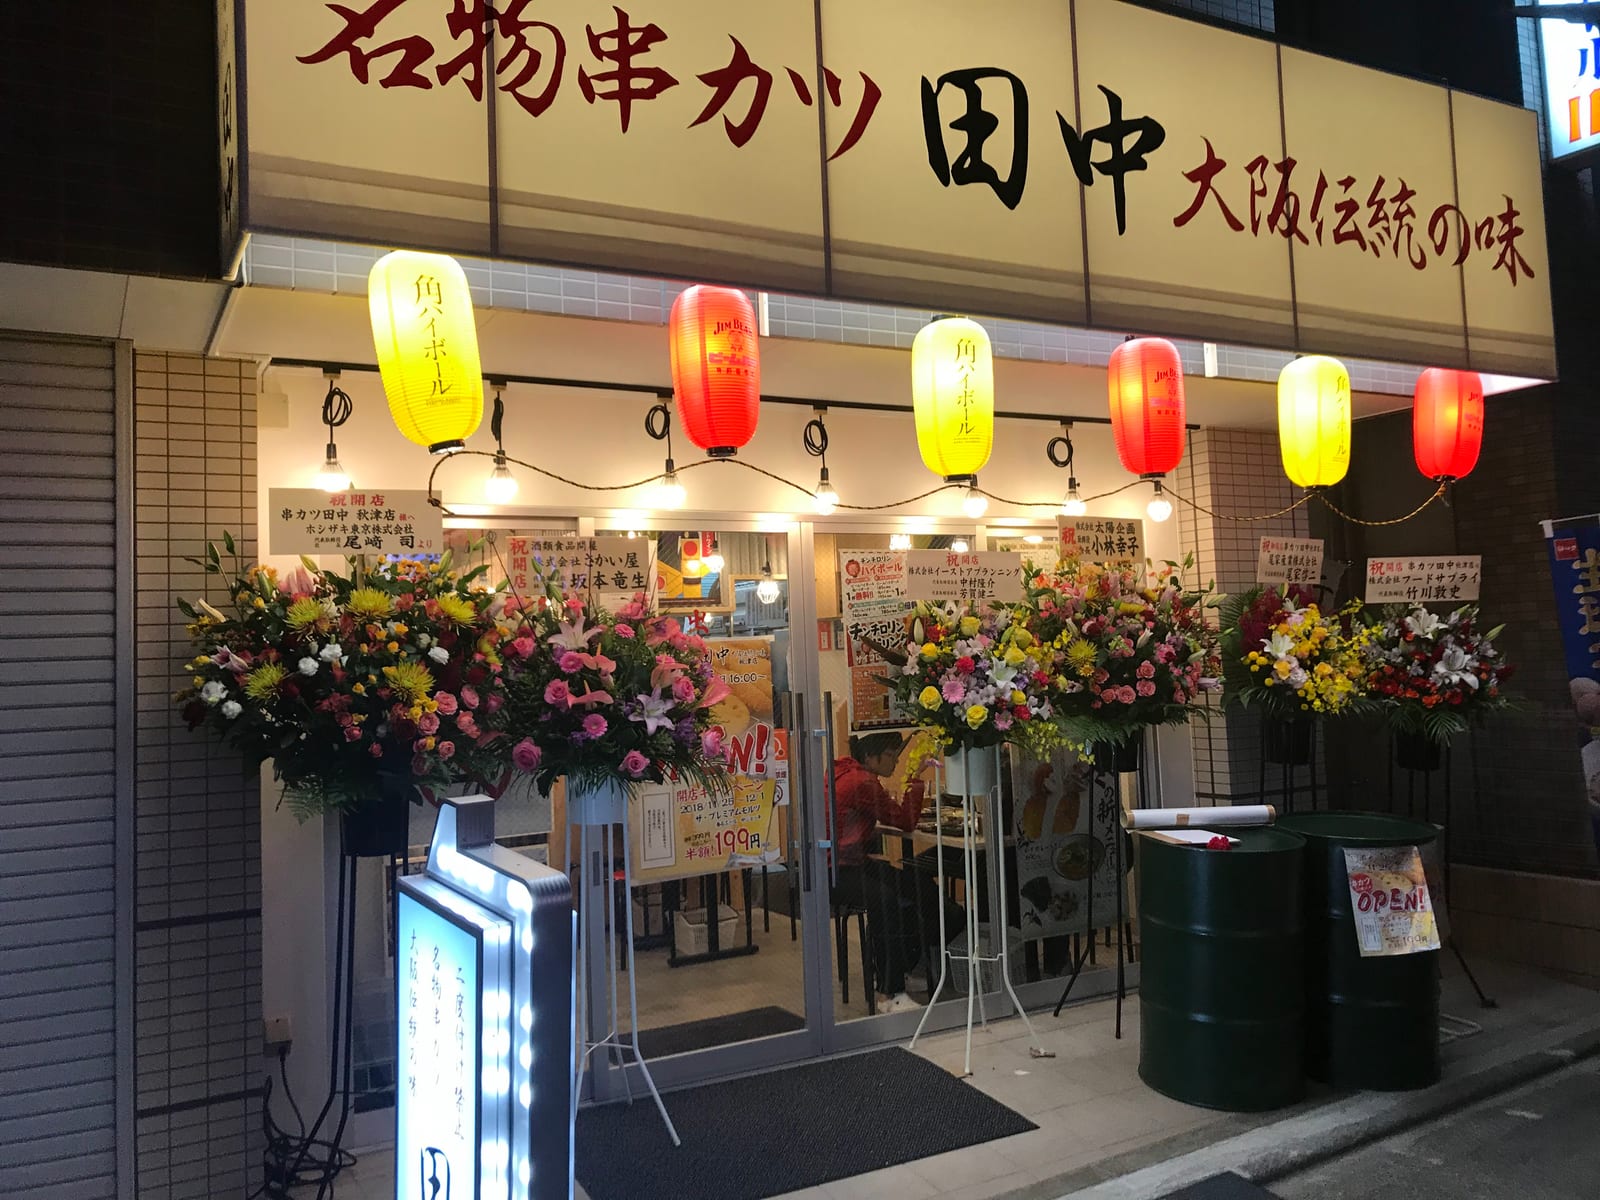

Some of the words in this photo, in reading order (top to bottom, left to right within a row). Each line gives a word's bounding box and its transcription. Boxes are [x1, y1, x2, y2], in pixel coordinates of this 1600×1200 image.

[296, 0, 882, 162] 名物串カツ
[921, 67, 1166, 236] 田中
[1173, 136, 1535, 287] 大阪伝統の味
[414, 274, 453, 396] 角ハイボール
[714, 321, 732, 335] JIM
[956, 338, 976, 436] 角ハイボール
[330, 494, 385, 507] 祝開店
[281, 508, 349, 521] 串カツ田中
[356, 509, 396, 522] 秋津店
[305, 524, 415, 535] ホシザキ東京株式会社
[1061, 527, 1076, 545] 祝
[400, 535, 415, 549] 司
[1092, 535, 1139, 557] 小林幸子
[510, 538, 529, 589] 祝開店
[946, 552, 979, 567] 祝開店
[862, 562, 903, 576] ハイボール
[1368, 572, 1478, 584] 株式会社フードサプライ
[570, 571, 647, 590] 坂本竜生
[849, 621, 905, 641] チンチロリン
[1357, 887, 1425, 913] OPEN!
